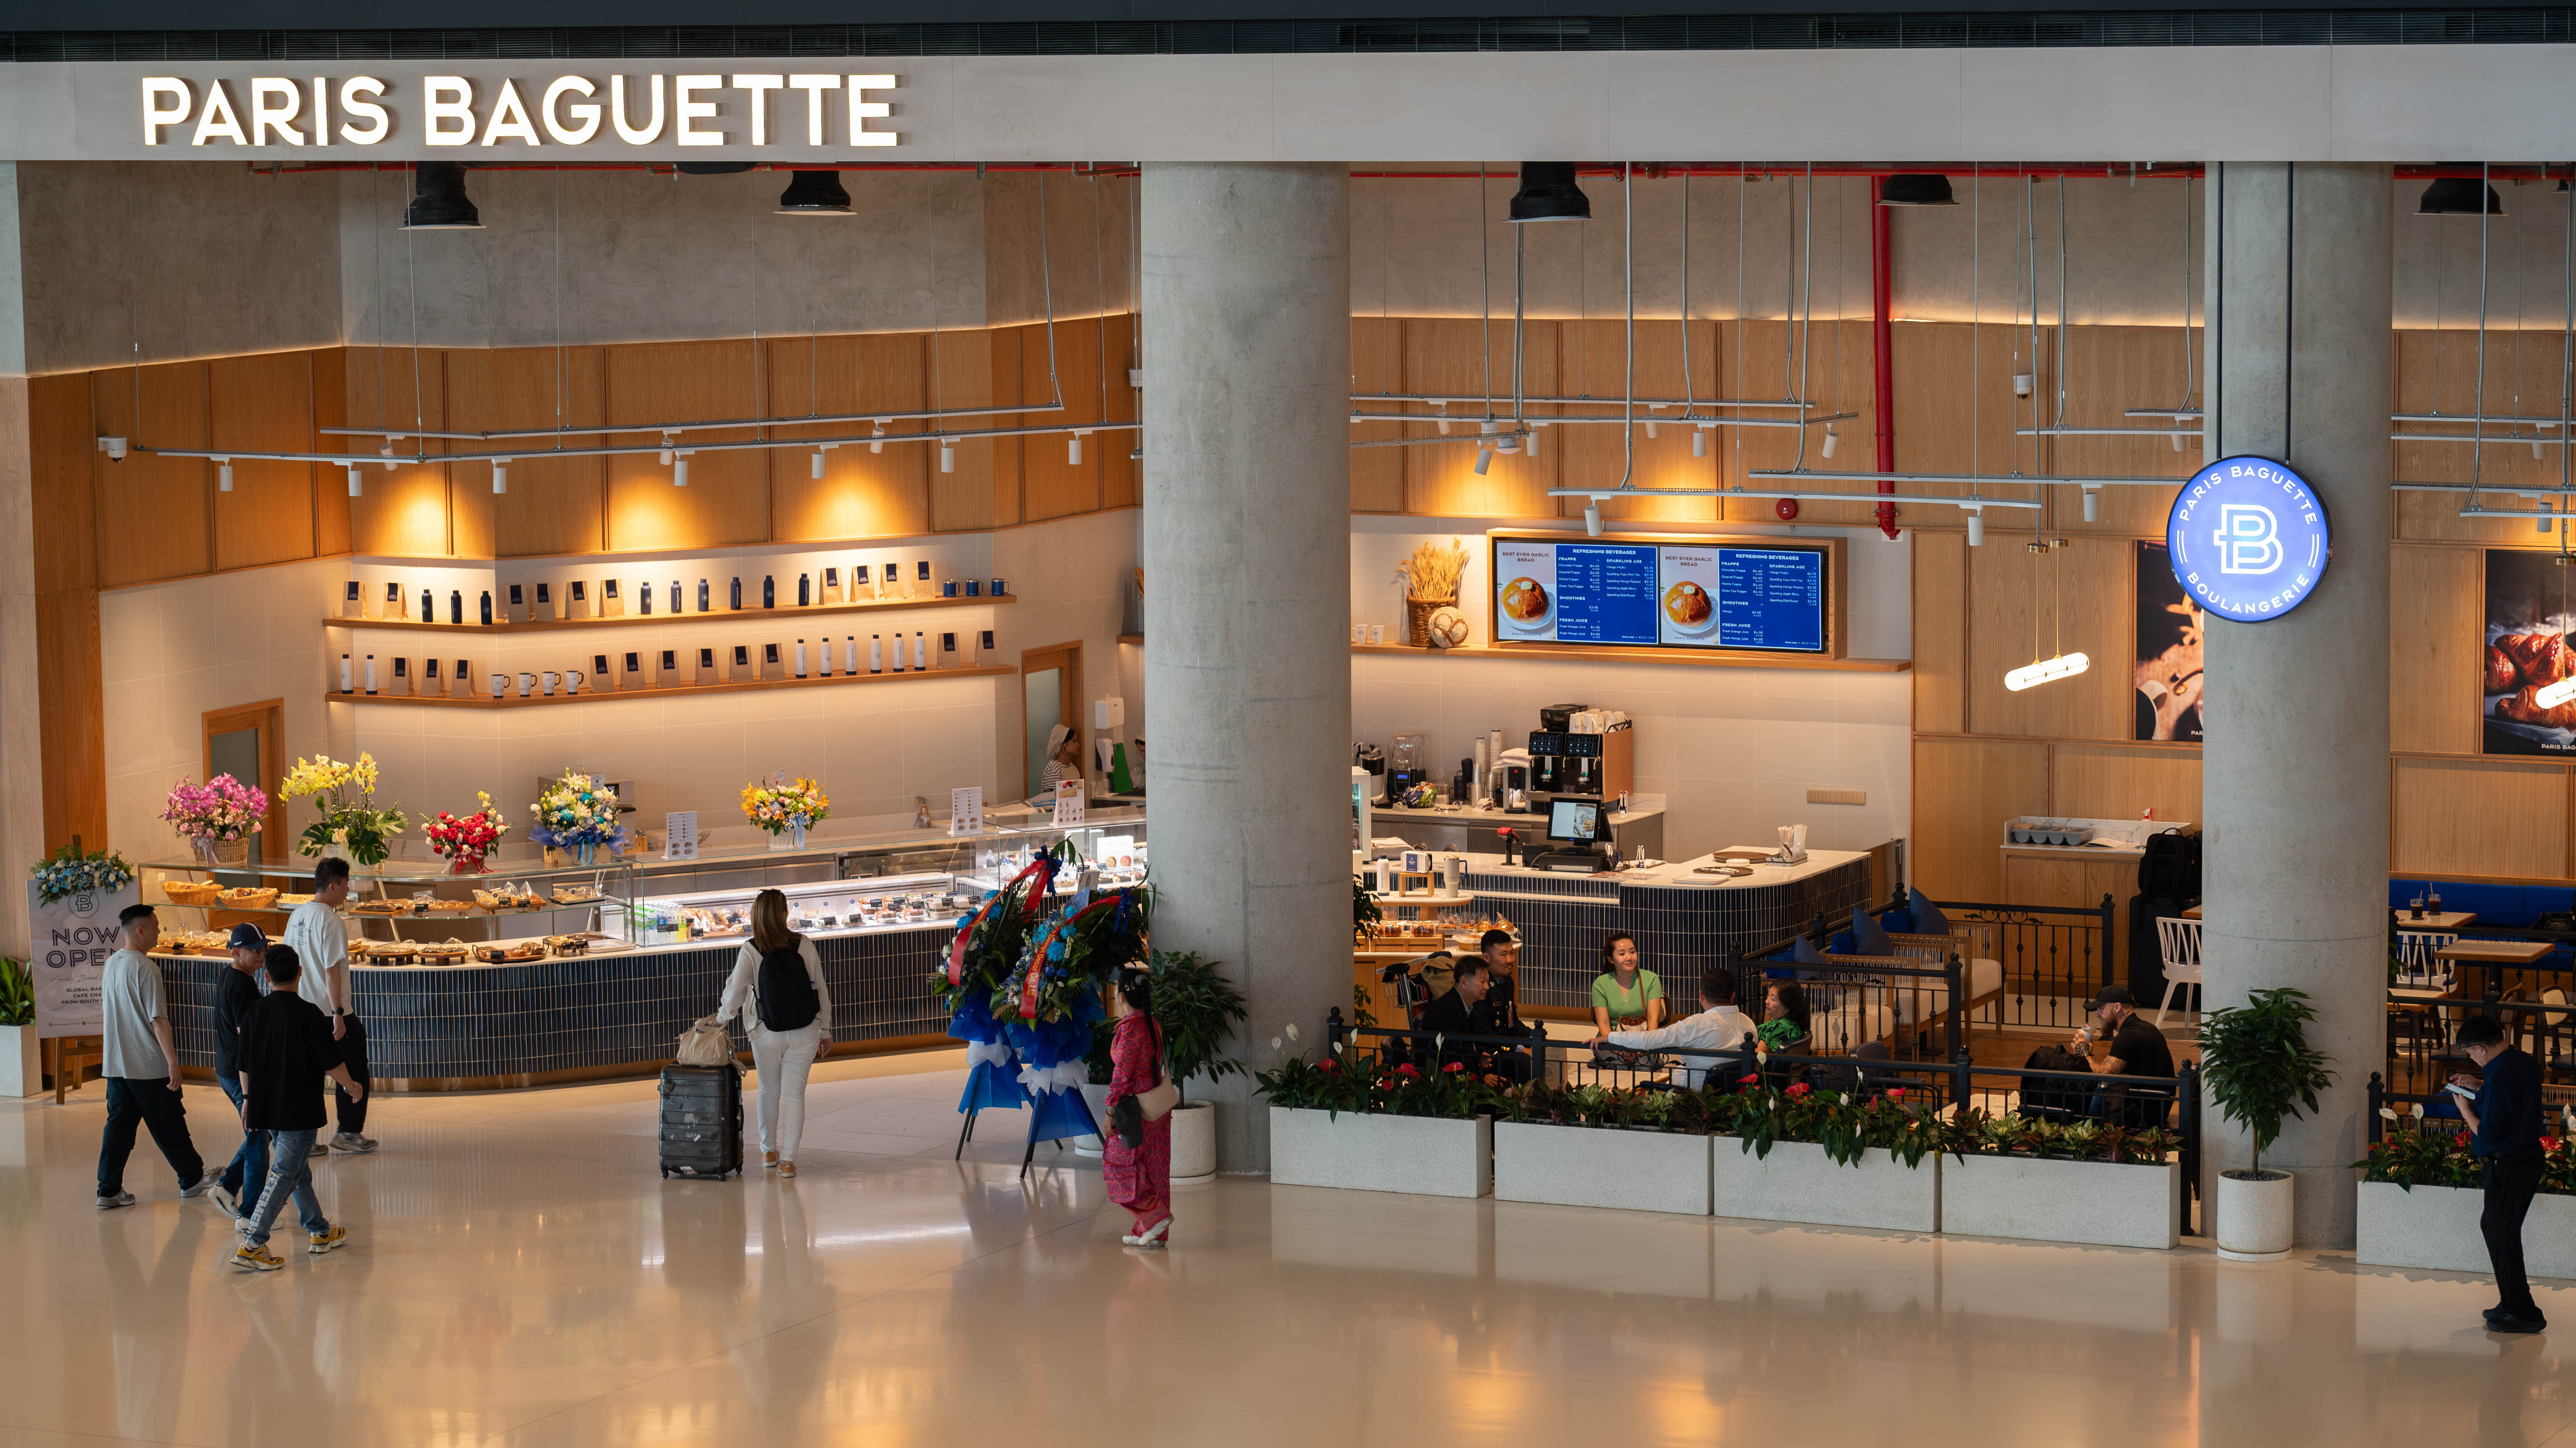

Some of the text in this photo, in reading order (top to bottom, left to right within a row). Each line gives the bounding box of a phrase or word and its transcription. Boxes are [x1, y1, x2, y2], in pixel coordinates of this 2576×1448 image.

[142, 74, 897, 146] PARIS BAGUETTE
[2179, 465, 2317, 525] PARIS BAGUETTE
[2187, 572, 2309, 614] BOULANGERIE
[52, 926, 120, 946] NOW
[1040, 934, 1055, 953] Design
[1031, 953, 1044, 972] Decor
